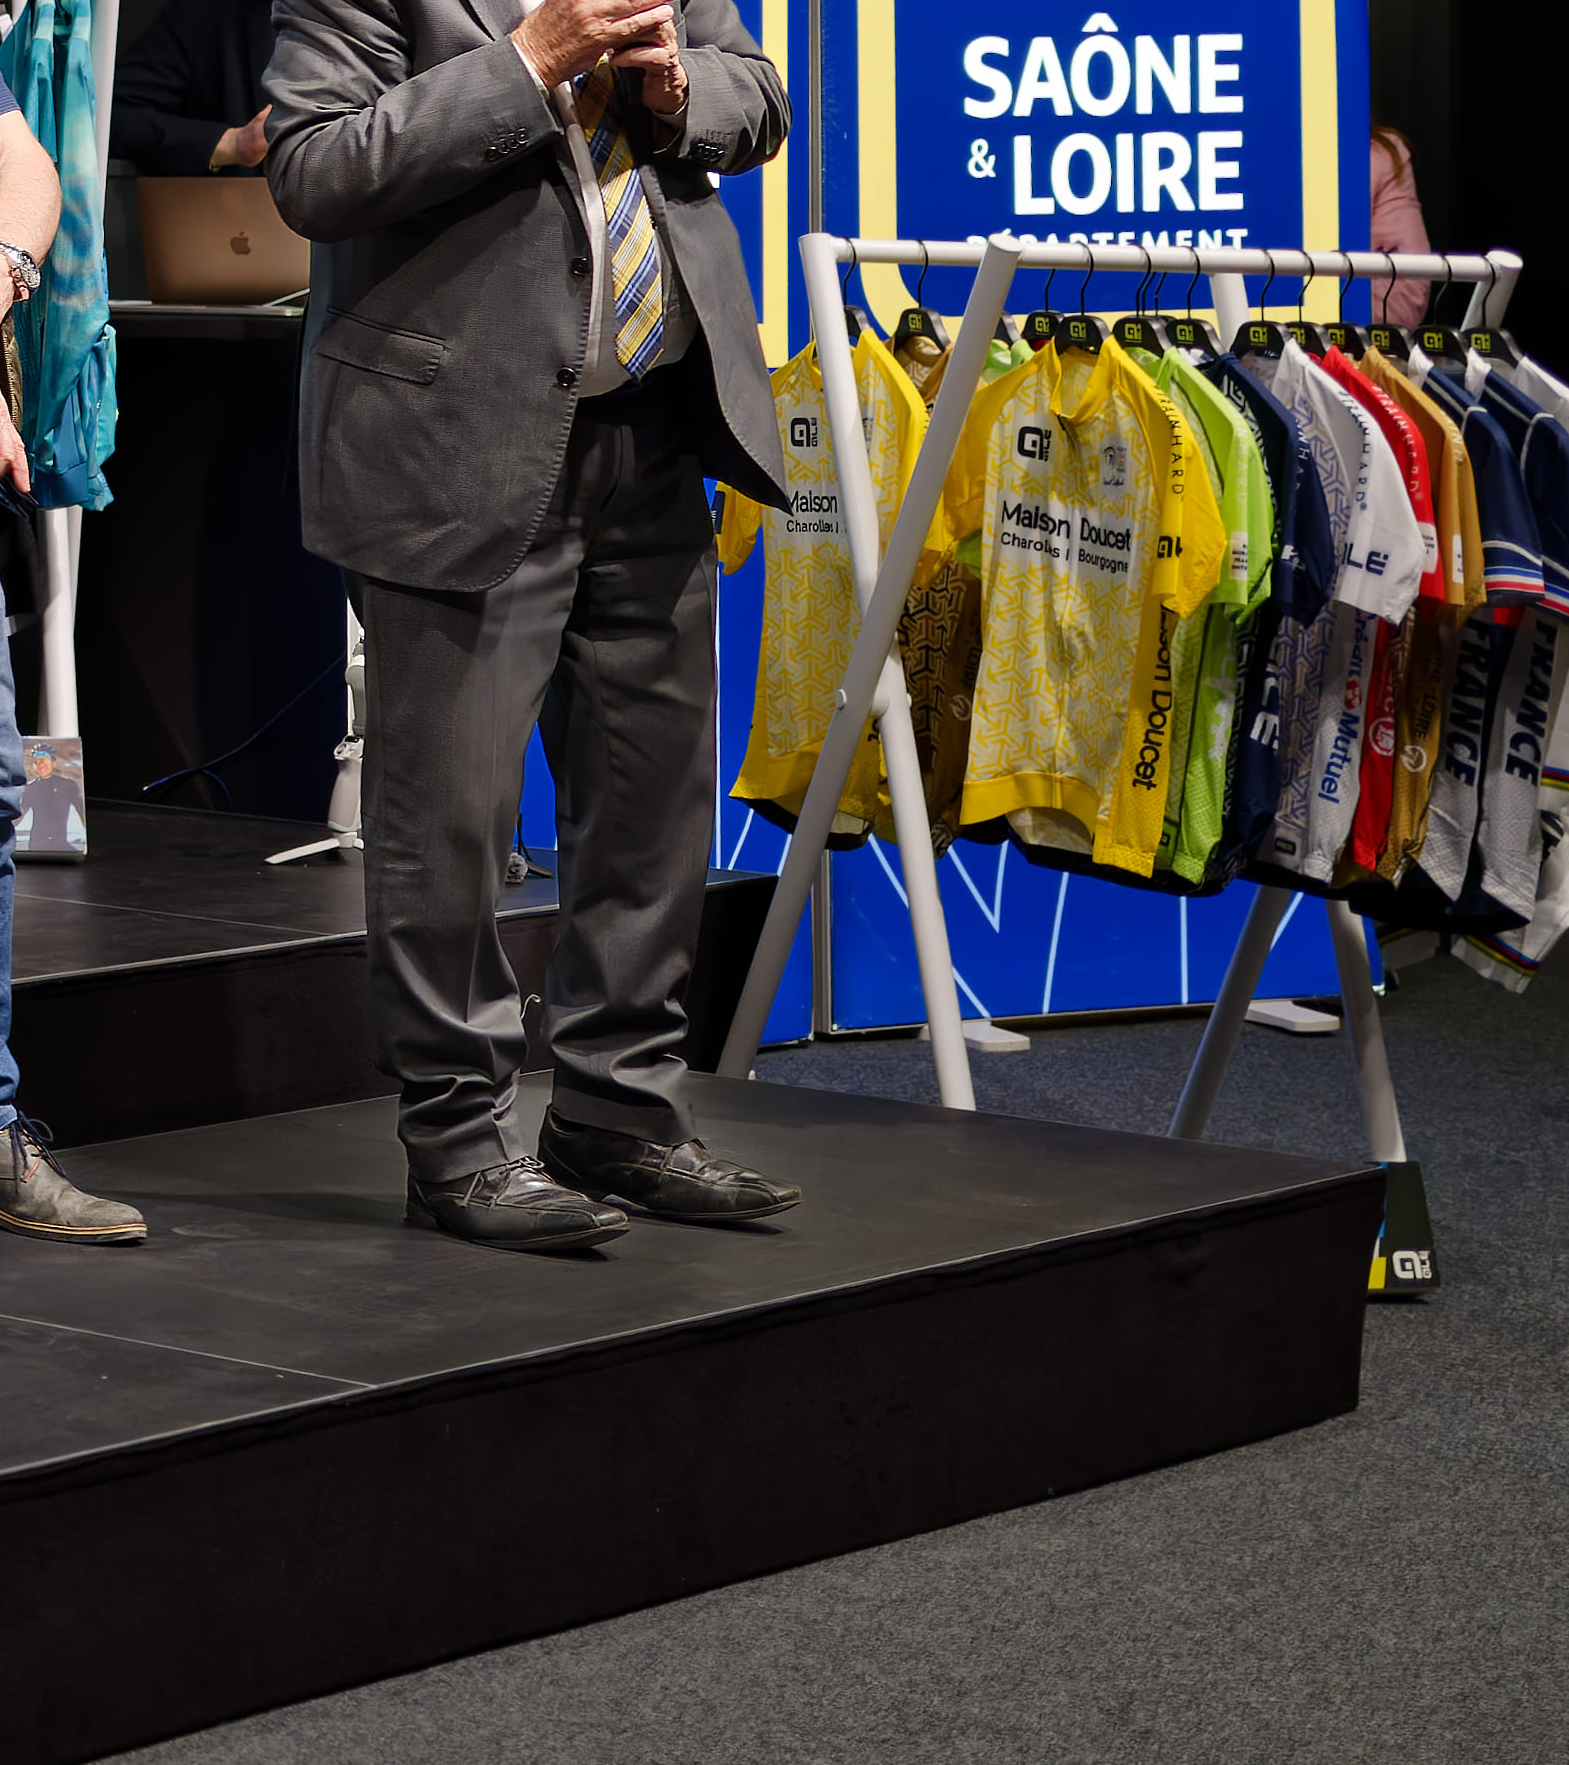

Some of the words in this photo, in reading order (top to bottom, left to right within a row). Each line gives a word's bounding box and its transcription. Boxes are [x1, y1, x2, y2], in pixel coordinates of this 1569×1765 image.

[963, 12, 1244, 119] SAÔNE
[967, 138, 996, 178] &
[1013, 131, 1244, 215] LOIRE
[1080, 517, 1131, 552] Doucet
[1132, 689, 1173, 791] Doucet
[1444, 616, 1493, 787] FRANCE
[1505, 618, 1559, 787] FRANCE
[1317, 711, 1361, 804] Mutuel
